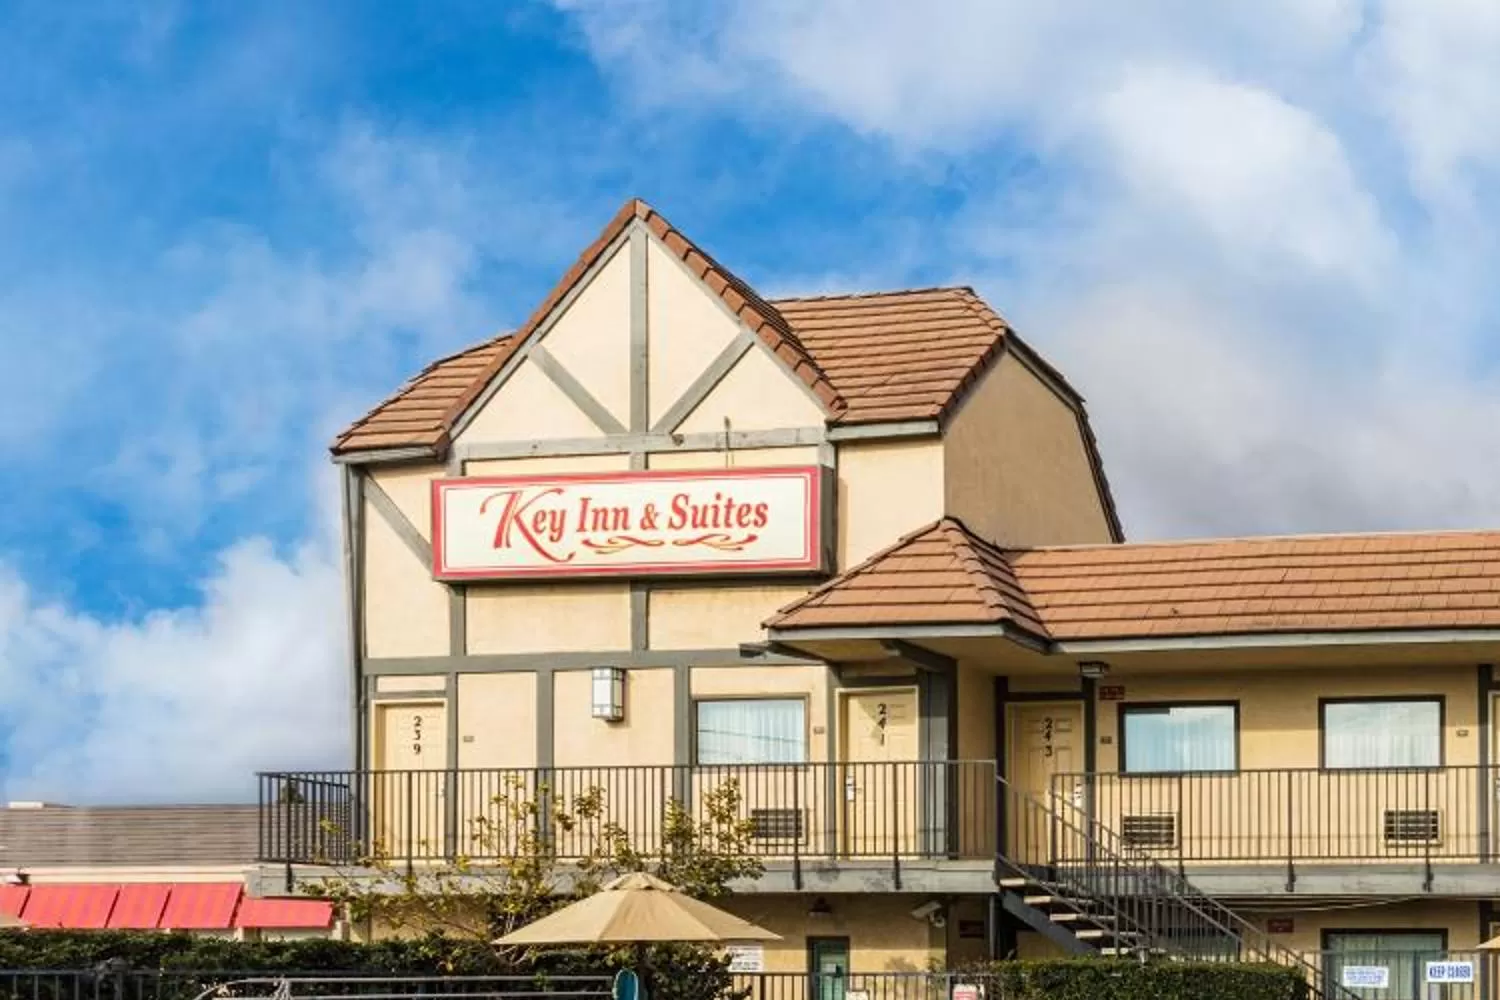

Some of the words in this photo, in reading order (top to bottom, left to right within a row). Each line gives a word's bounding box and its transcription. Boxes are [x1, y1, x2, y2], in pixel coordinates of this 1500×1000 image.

[480, 488, 576, 563] Key
[576, 497, 630, 533] Inn
[640, 503, 659, 530] &
[667, 493, 769, 530] Suites
[877, 703, 888, 747] 241
[1429, 965, 1446, 979] KEEP
